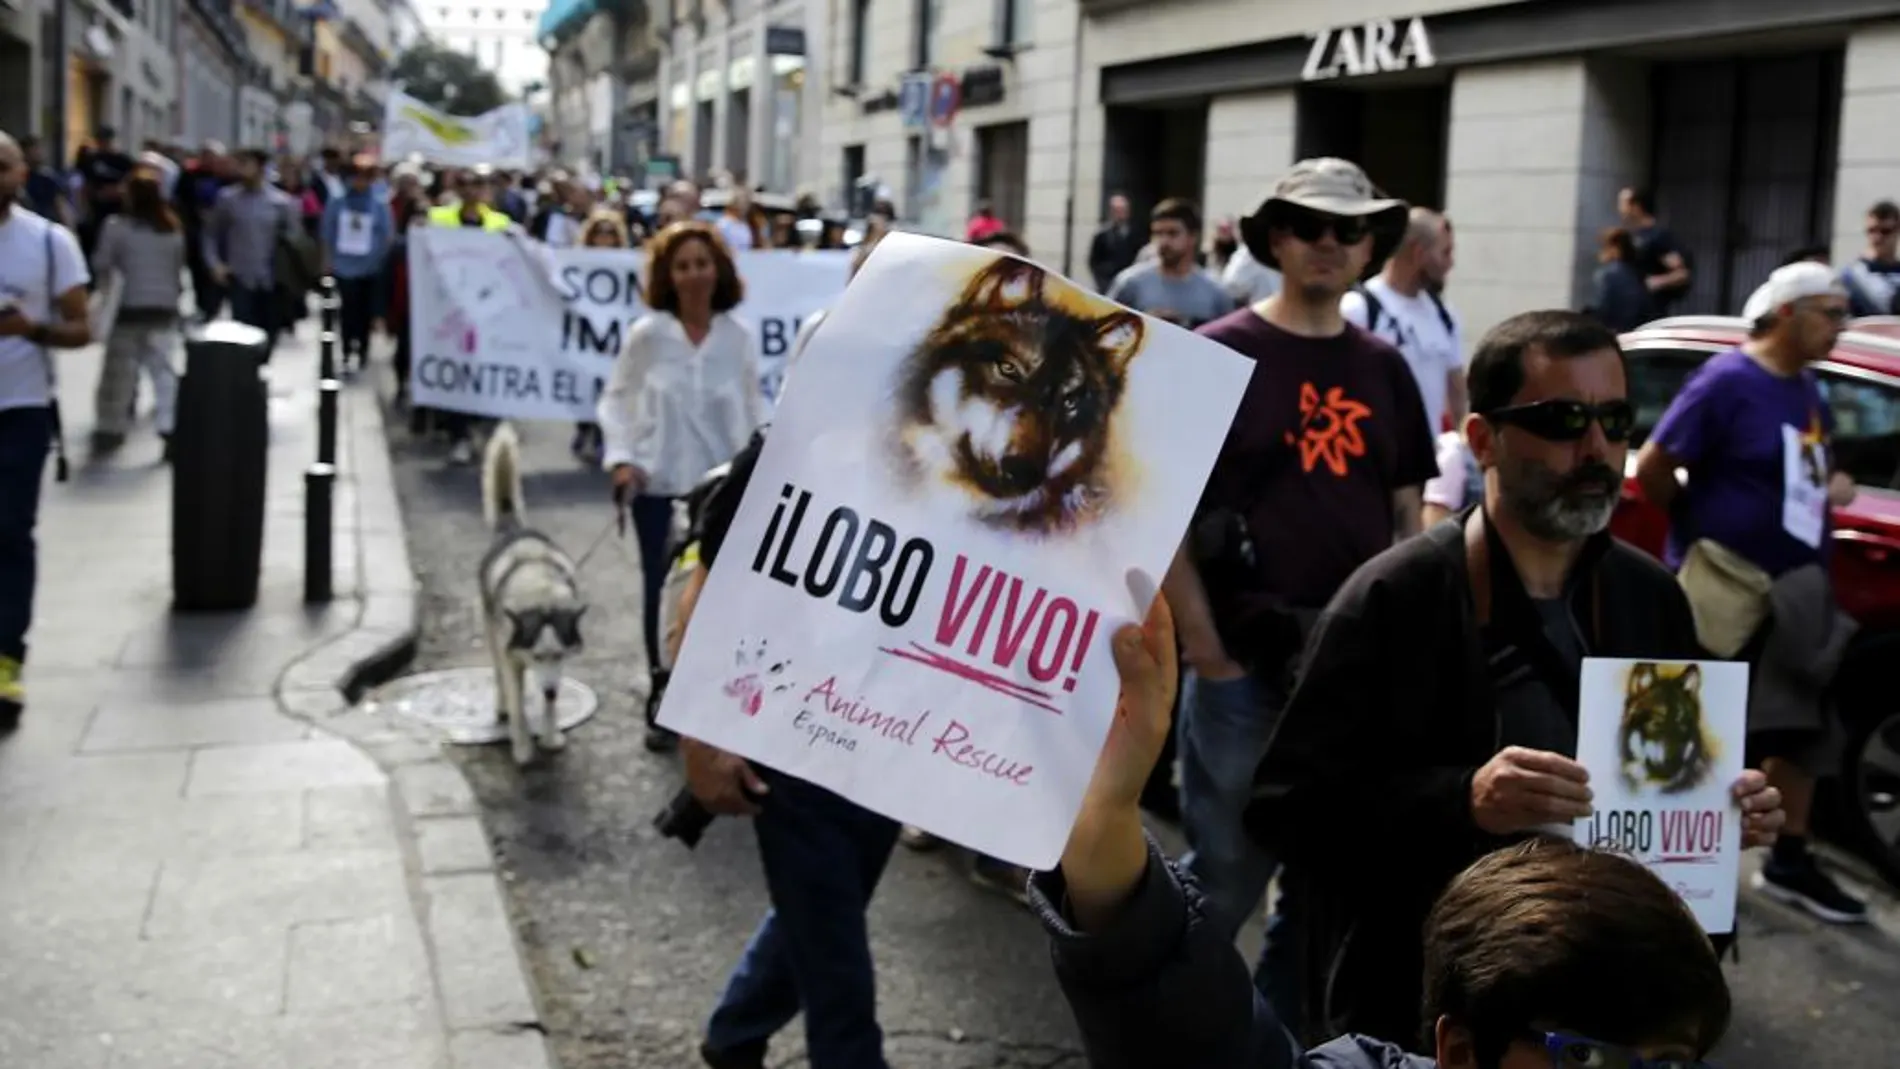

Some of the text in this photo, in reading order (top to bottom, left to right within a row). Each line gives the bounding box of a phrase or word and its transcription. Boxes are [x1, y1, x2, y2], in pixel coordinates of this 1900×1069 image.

[1301, 16, 1435, 81] ZARA
[418, 353, 542, 400] CONTRA
[552, 369, 583, 405] EL
[935, 553, 1099, 693] VIVO!
[803, 675, 1033, 785] Animal Rescue
[1660, 810, 1723, 853] VIVO!
